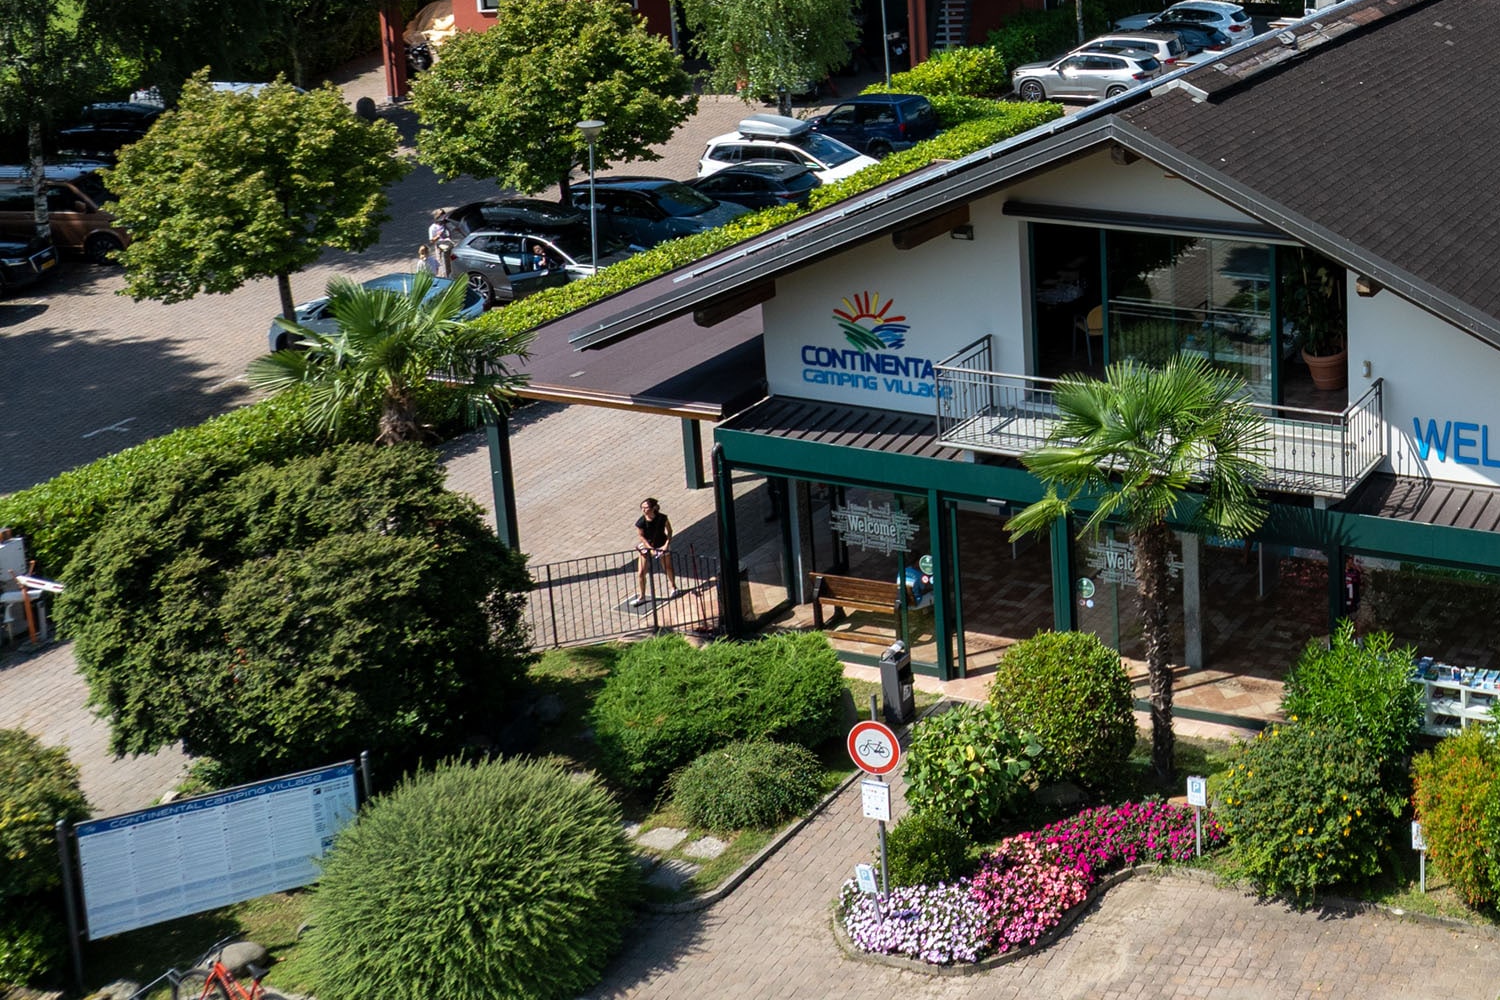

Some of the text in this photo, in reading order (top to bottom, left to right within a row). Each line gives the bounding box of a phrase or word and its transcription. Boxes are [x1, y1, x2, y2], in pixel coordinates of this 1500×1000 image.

[847, 515, 897, 537] Welcome
[1193, 782, 1200, 792] P
[109, 802, 204, 828] CONTINENTAL
